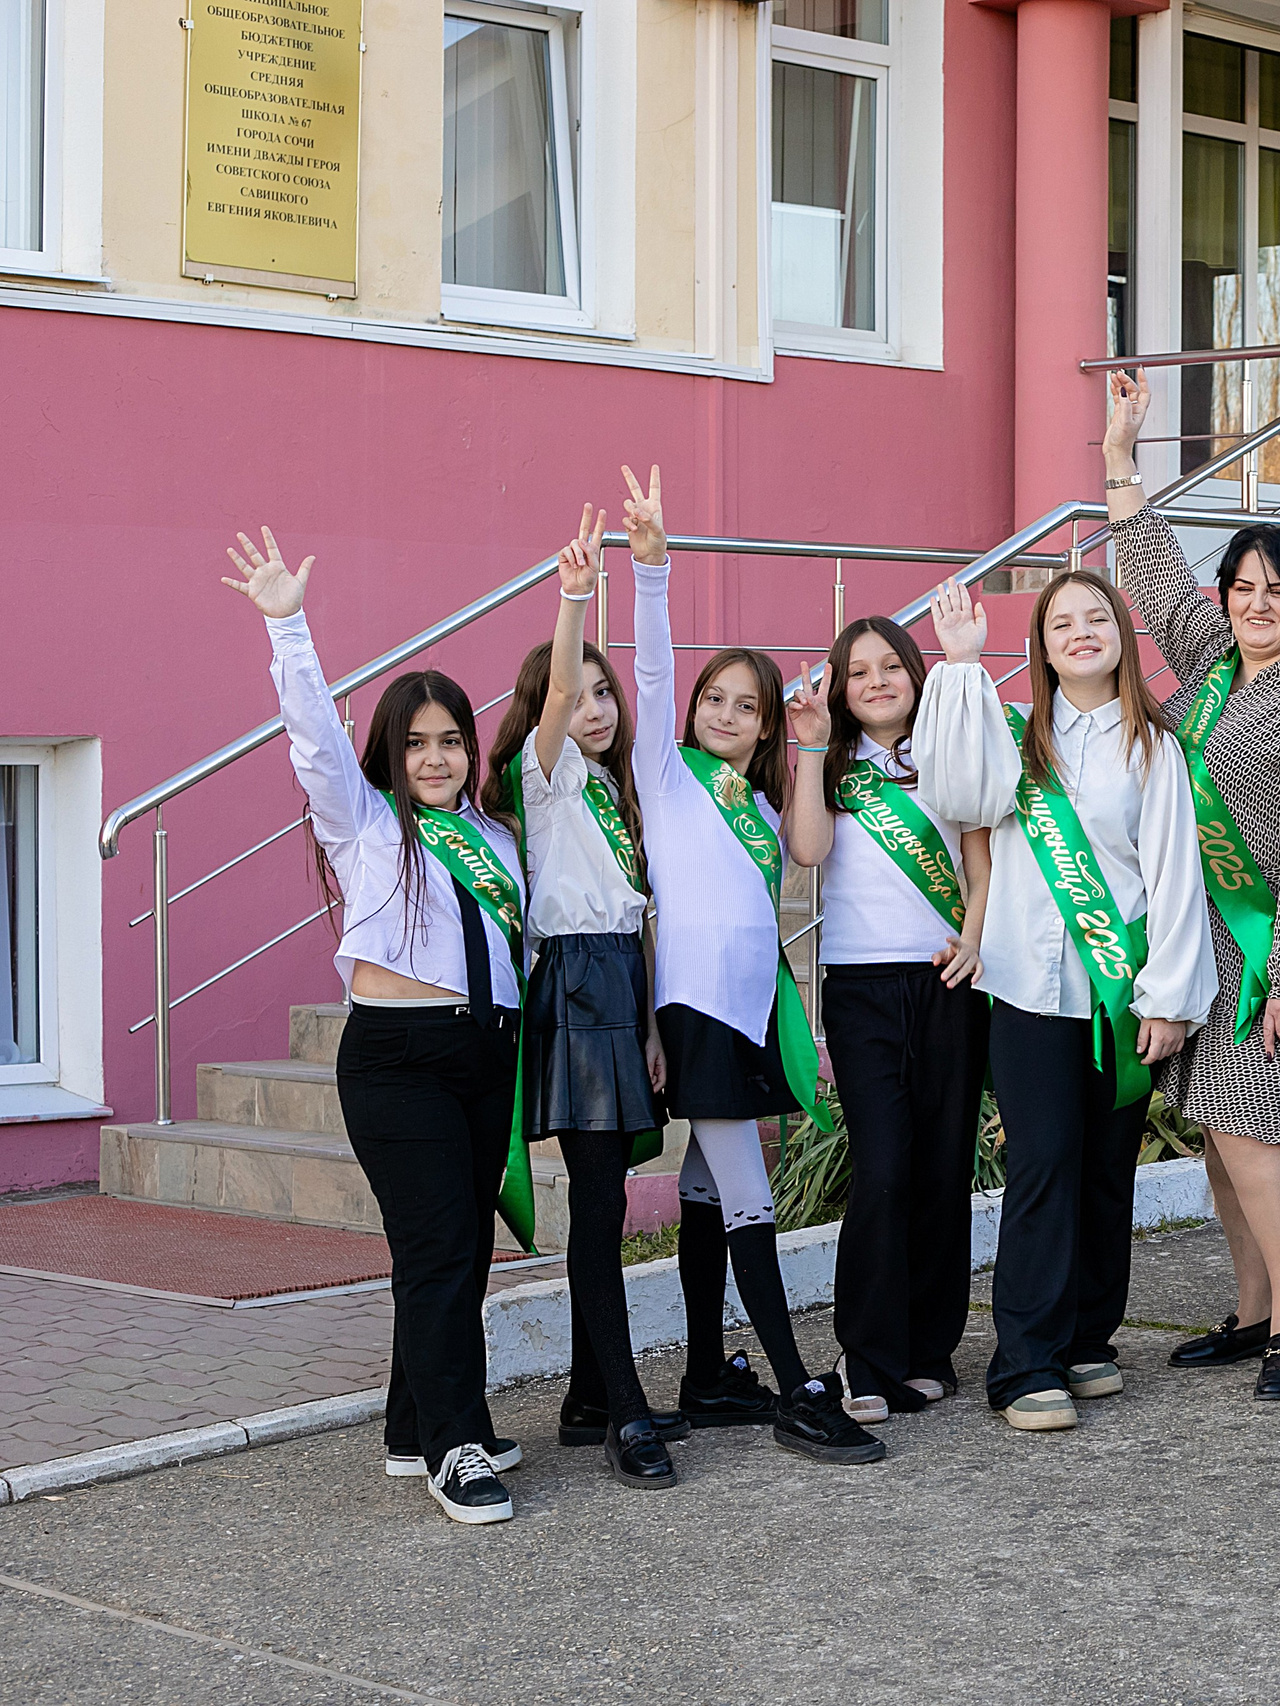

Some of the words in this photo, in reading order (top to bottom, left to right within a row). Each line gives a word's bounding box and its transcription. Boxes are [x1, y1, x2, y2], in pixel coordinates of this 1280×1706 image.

[206, 4, 346, 40] ОБЩЕОБРАЗОВАТЕЛЬНОЕ
[244, 0, 330, 18] ИПАЛЬНОЕ
[240, 29, 314, 53] БЮДЖЕТНОЕ
[237, 48, 317, 72] УЧРЕЖДЕНИЕ
[250, 70, 304, 89] СРЕДНЯЯ
[203, 82, 345, 116] ОБЩЕОБРАЗОВАТЕЛЬНАЯ
[241, 108, 286, 125] ШКОЛА
[287, 115, 300, 127] №
[300, 118, 312, 129] 67
[236, 127, 282, 144] ГОРОДА
[283, 134, 315, 149] СОЧИ
[206, 142, 251, 159] ИМЕНИ
[252, 148, 305, 167] ДВАЖДЫ
[306, 157, 341, 173] ГЕРОЯ
[215, 163, 291, 184] СОВЕТСКОГО
[292, 174, 331, 191] СОЮЗА
[239, 186, 309, 206] САВИЦКОГО
[207, 201, 262, 219] ЕВГЕНИЯ
[263, 208, 338, 230] ЯКОВЛЕВИЧА
[836, 761, 956, 902] Выпускница
[1197, 820, 1254, 891] 2025
[1066, 909, 1133, 980] 2025
